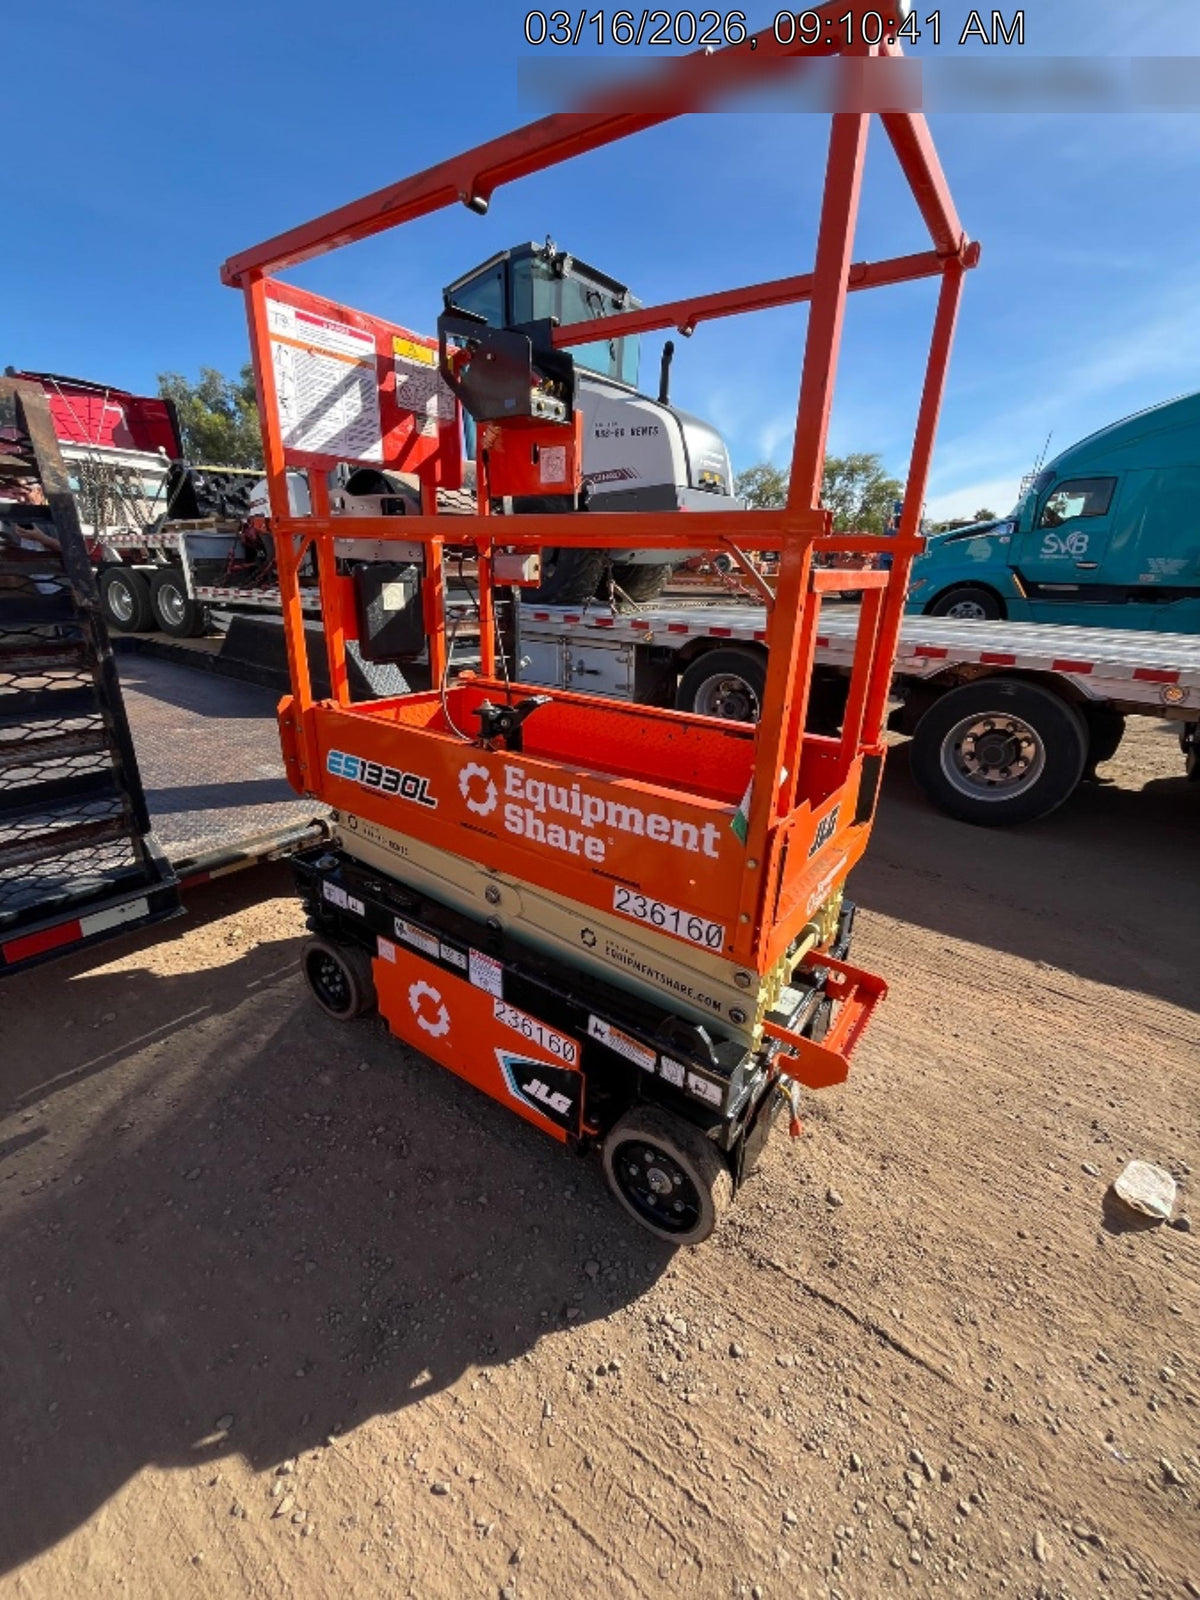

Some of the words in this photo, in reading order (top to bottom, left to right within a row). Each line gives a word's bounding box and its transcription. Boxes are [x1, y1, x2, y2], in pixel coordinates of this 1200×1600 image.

[327, 749, 438, 809] ES1330L
[504, 764, 721, 859] Equipment
[504, 803, 606, 863] Share
[616, 888, 723, 948] 236160
[605, 946, 722, 1012] EQUIPMENTSHARE.COM
[495, 1000, 575, 1062] 236160
[522, 1078, 574, 1117] JLG
